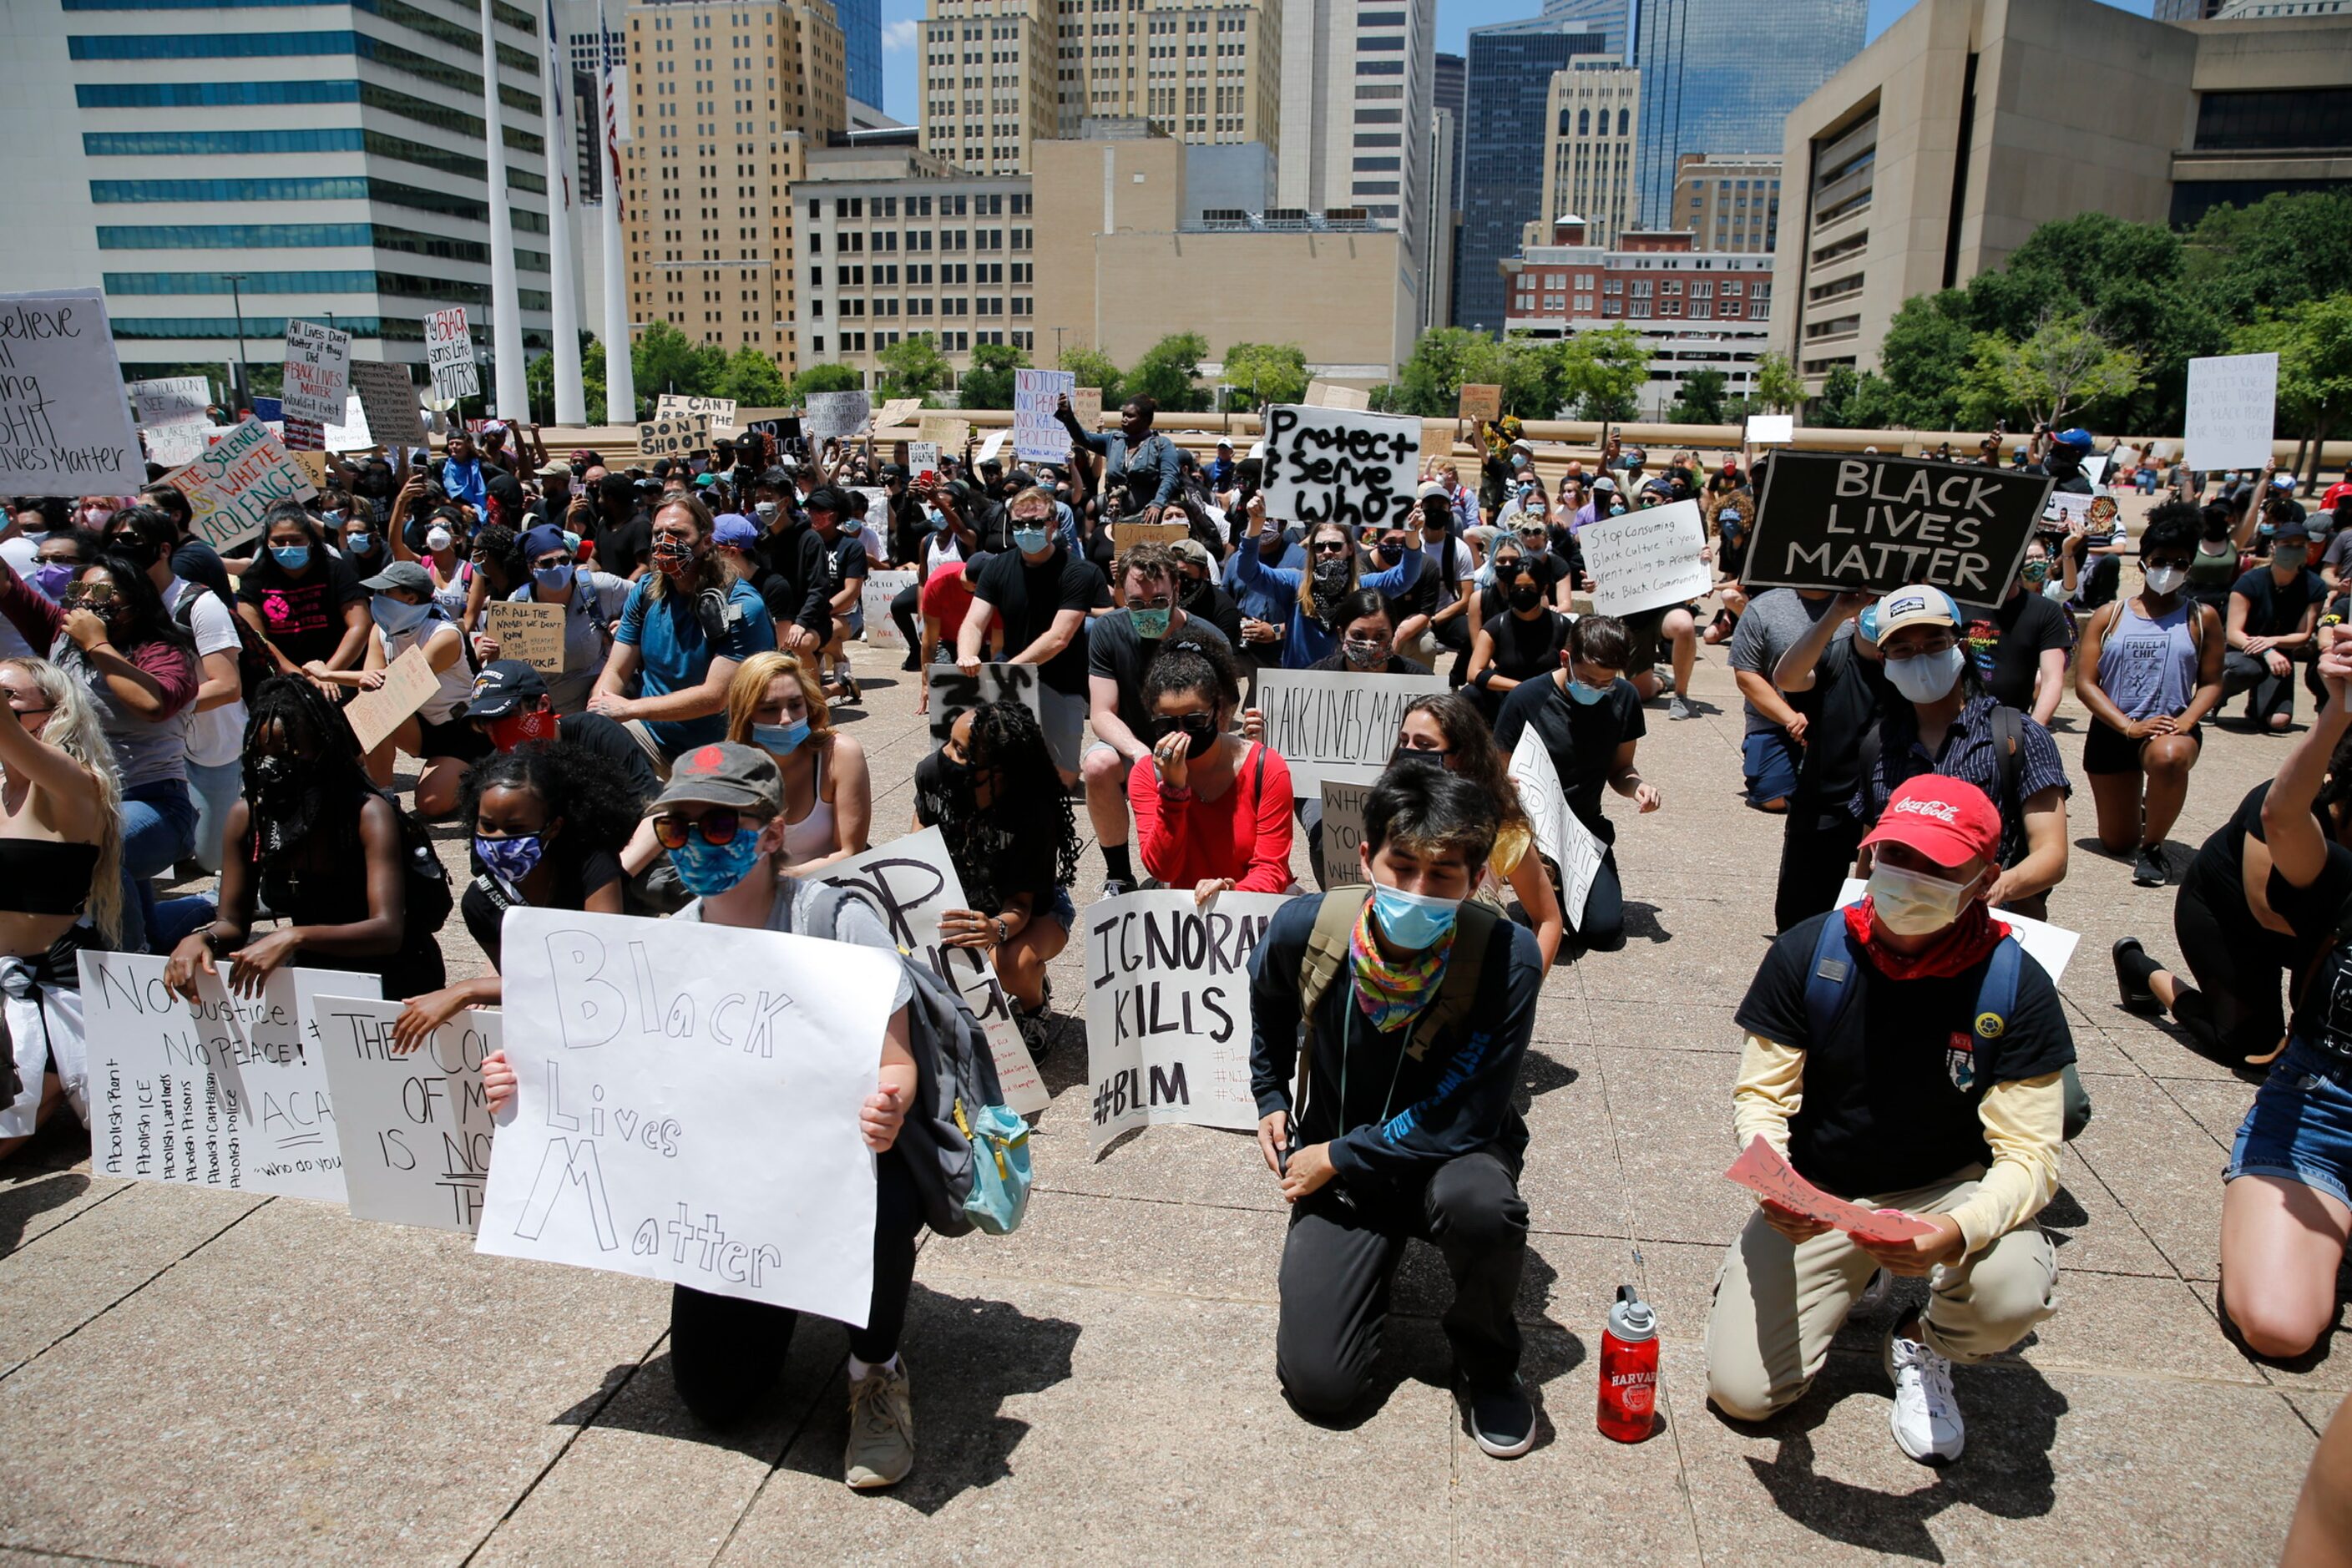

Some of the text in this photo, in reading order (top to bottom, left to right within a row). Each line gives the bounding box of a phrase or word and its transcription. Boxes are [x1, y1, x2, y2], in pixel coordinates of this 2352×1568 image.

[437, 308, 469, 341] BLACK
[306, 351, 319, 363] Did
[326, 344, 343, 361] they
[452, 340, 470, 358] Life
[316, 367, 342, 387] LIVES
[2193, 358, 2253, 375] AMERICA
[133, 382, 148, 396] IF
[153, 382, 175, 395] YOU
[301, 382, 331, 399] MATTER
[432, 361, 478, 401] MATTERS
[1019, 371, 1036, 392] NO
[144, 396, 195, 412] SEE AN
[662, 396, 677, 407] I
[1017, 392, 1034, 411] NO
[169, 426, 186, 438] ARE
[641, 414, 707, 438] DONT
[660, 411, 732, 426] BRTHE
[751, 421, 777, 437] NO
[1016, 413, 1034, 428] NO
[163, 435, 201, 448] OF THE
[641, 431, 707, 455] SHOOT
[772, 437, 801, 456] TICE
[1019, 430, 1069, 448] POLICE
[1269, 410, 1419, 464] Protect
[0, 447, 124, 474] ives Matter
[169, 465, 209, 491] ITE
[203, 422, 267, 478] SILENCE
[215, 443, 283, 497] WHITE
[1288, 449, 1393, 496] Serve
[1835, 460, 2002, 518] BLACK
[200, 463, 308, 548] VIOLENCE
[1591, 521, 1675, 549] Stop Consuming
[1827, 504, 1981, 548] LIVES
[1592, 551, 1621, 569] Black
[1626, 543, 1661, 558] Culture
[1666, 536, 1673, 547] if
[1784, 541, 1990, 591] MATTER
[1626, 560, 1651, 574] willing
[1656, 559, 1665, 569] to
[1599, 590, 1616, 604] the
[1622, 582, 1649, 599] Black
[491, 604, 549, 619] FOR ALL THE
[503, 630, 522, 642] KNOW
[2126, 640, 2167, 650] FAVELA
[2132, 650, 2157, 659] CHIC
[1262, 686, 1363, 760] BLACK LIVES
[1894, 796, 1960, 822] Coca-Cola
[1115, 981, 1234, 1047] KILLS
[331, 1013, 408, 1061] THE
[210, 1037, 307, 1070] PEACE!
[403, 1076, 495, 1129] OF M
[1093, 1062, 1190, 1126] #BLM
[106, 1059, 123, 1173] Abolish Rent
[264, 1091, 336, 1134] ACA
[546, 1059, 682, 1158] Lives
[136, 1080, 154, 1175] Abolish ICE
[181, 1080, 198, 1182] Abolish Prisons
[226, 1089, 241, 1189] Abolish Police
[163, 1130, 176, 1180] Abolish
[205, 1135, 221, 1184] Abolish
[378, 1129, 493, 1174] IS NO
[296, 1155, 341, 1178] do you
[435, 1182, 483, 1225] TH
[514, 1136, 781, 1288] Matter
[1611, 1372, 1657, 1386] HARVAR
